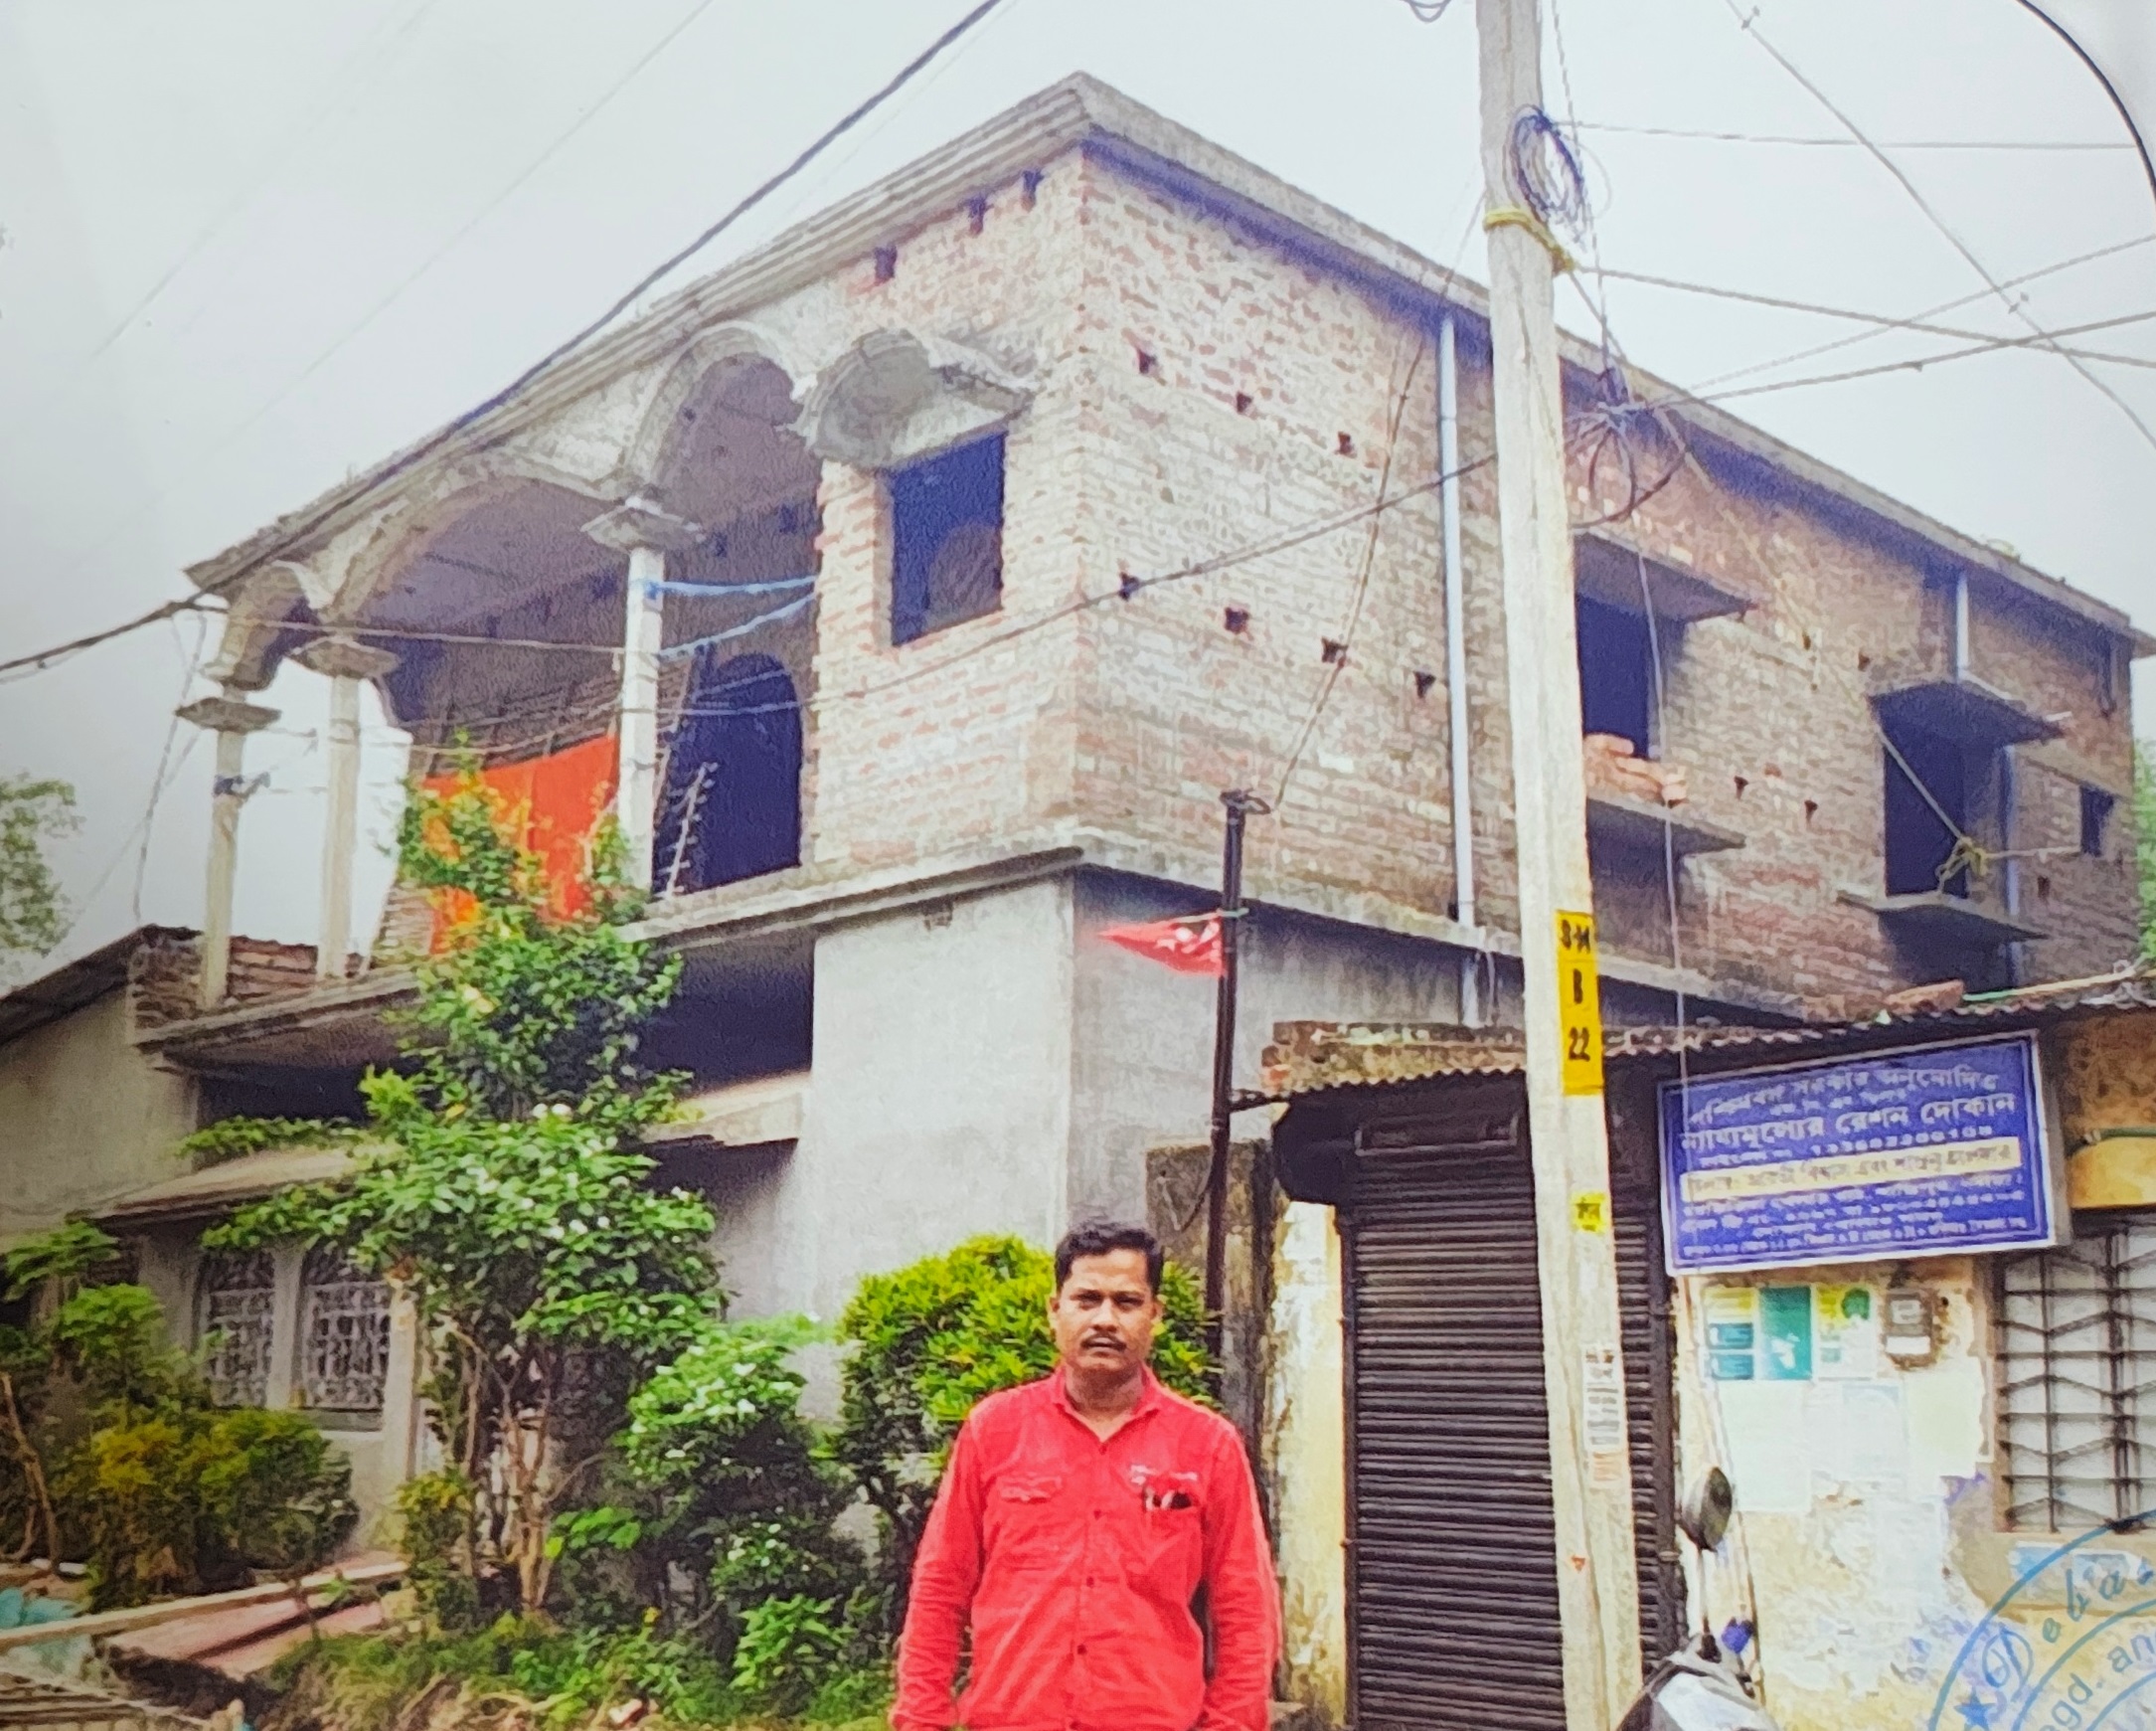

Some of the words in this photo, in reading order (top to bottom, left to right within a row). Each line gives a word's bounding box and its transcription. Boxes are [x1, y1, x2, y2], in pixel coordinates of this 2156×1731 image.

[1568, 1026, 1590, 1062] 22
[1835, 1105, 1909, 1135] রেশন
[1920, 1093, 2017, 1125] দোকান
